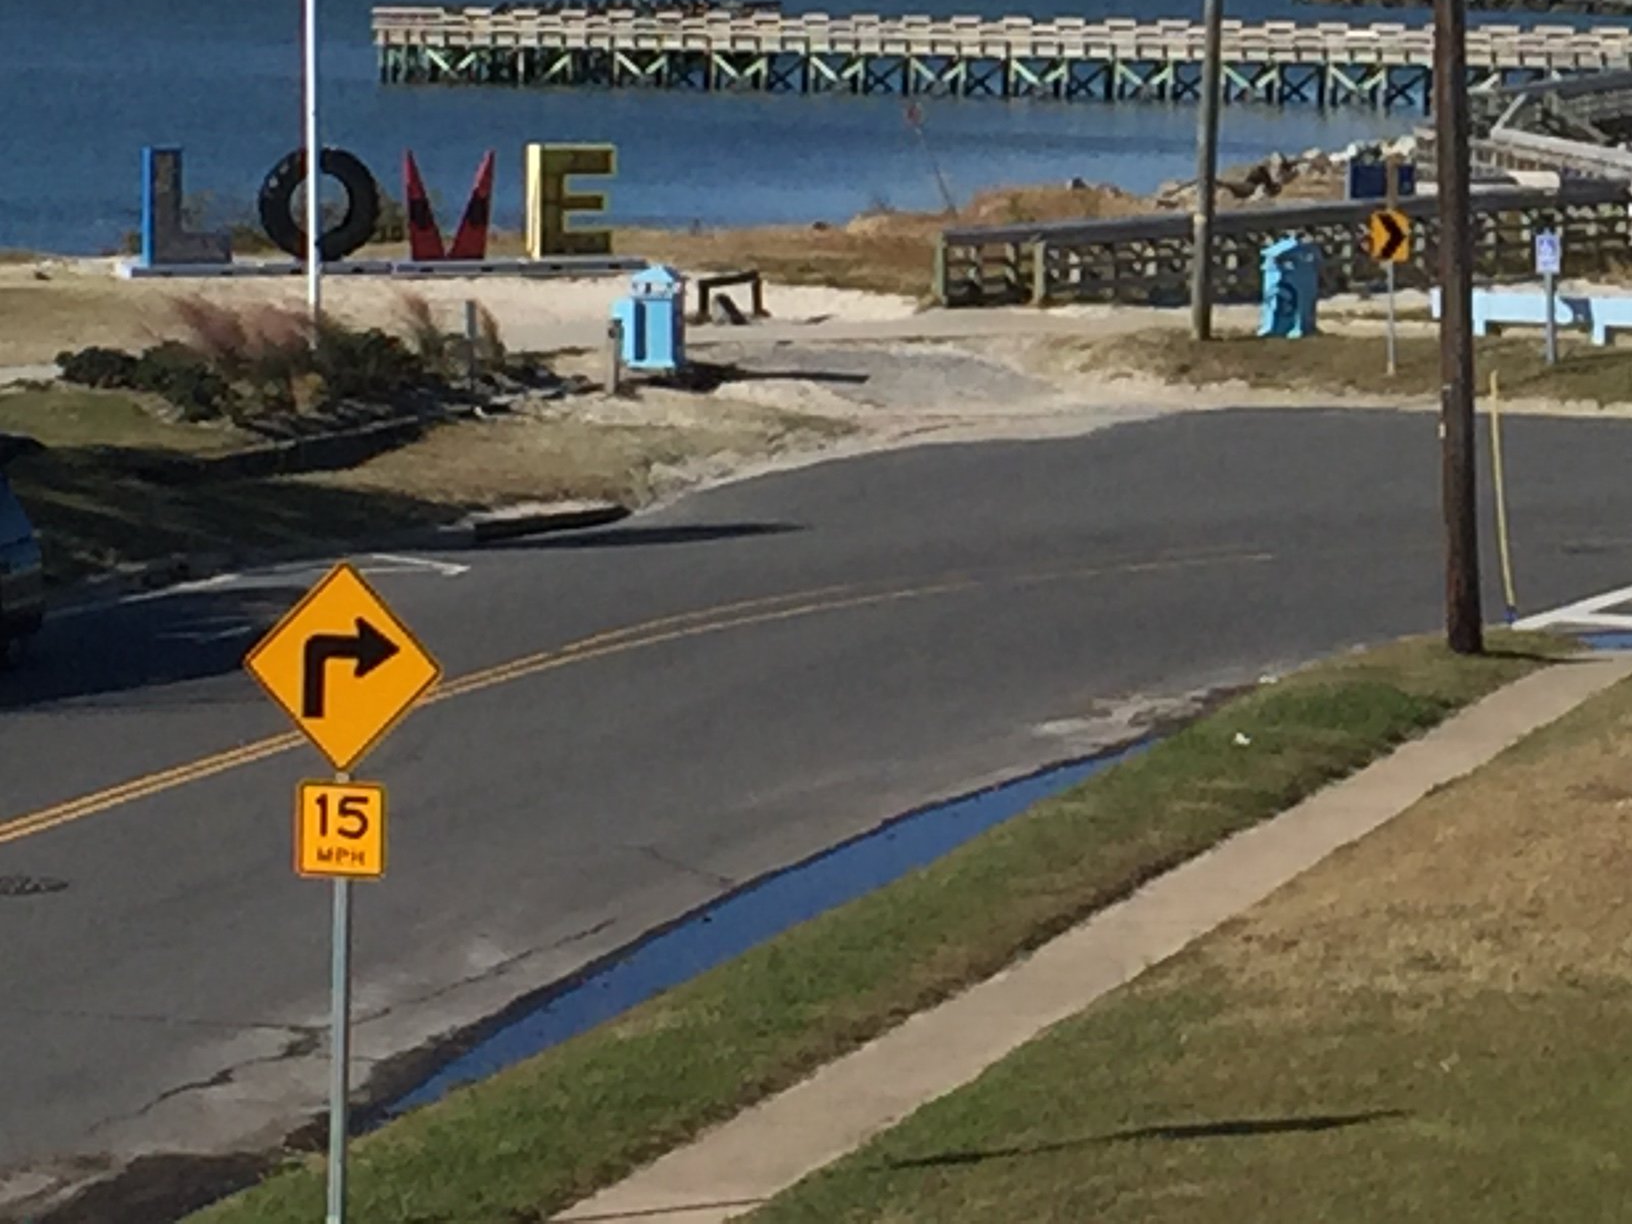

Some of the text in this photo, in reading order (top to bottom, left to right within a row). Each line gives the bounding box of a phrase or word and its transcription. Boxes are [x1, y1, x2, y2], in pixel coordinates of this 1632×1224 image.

[141, 143, 616, 267] LOVE
[315, 793, 369, 840] 15
[316, 847, 366, 866] MPH
